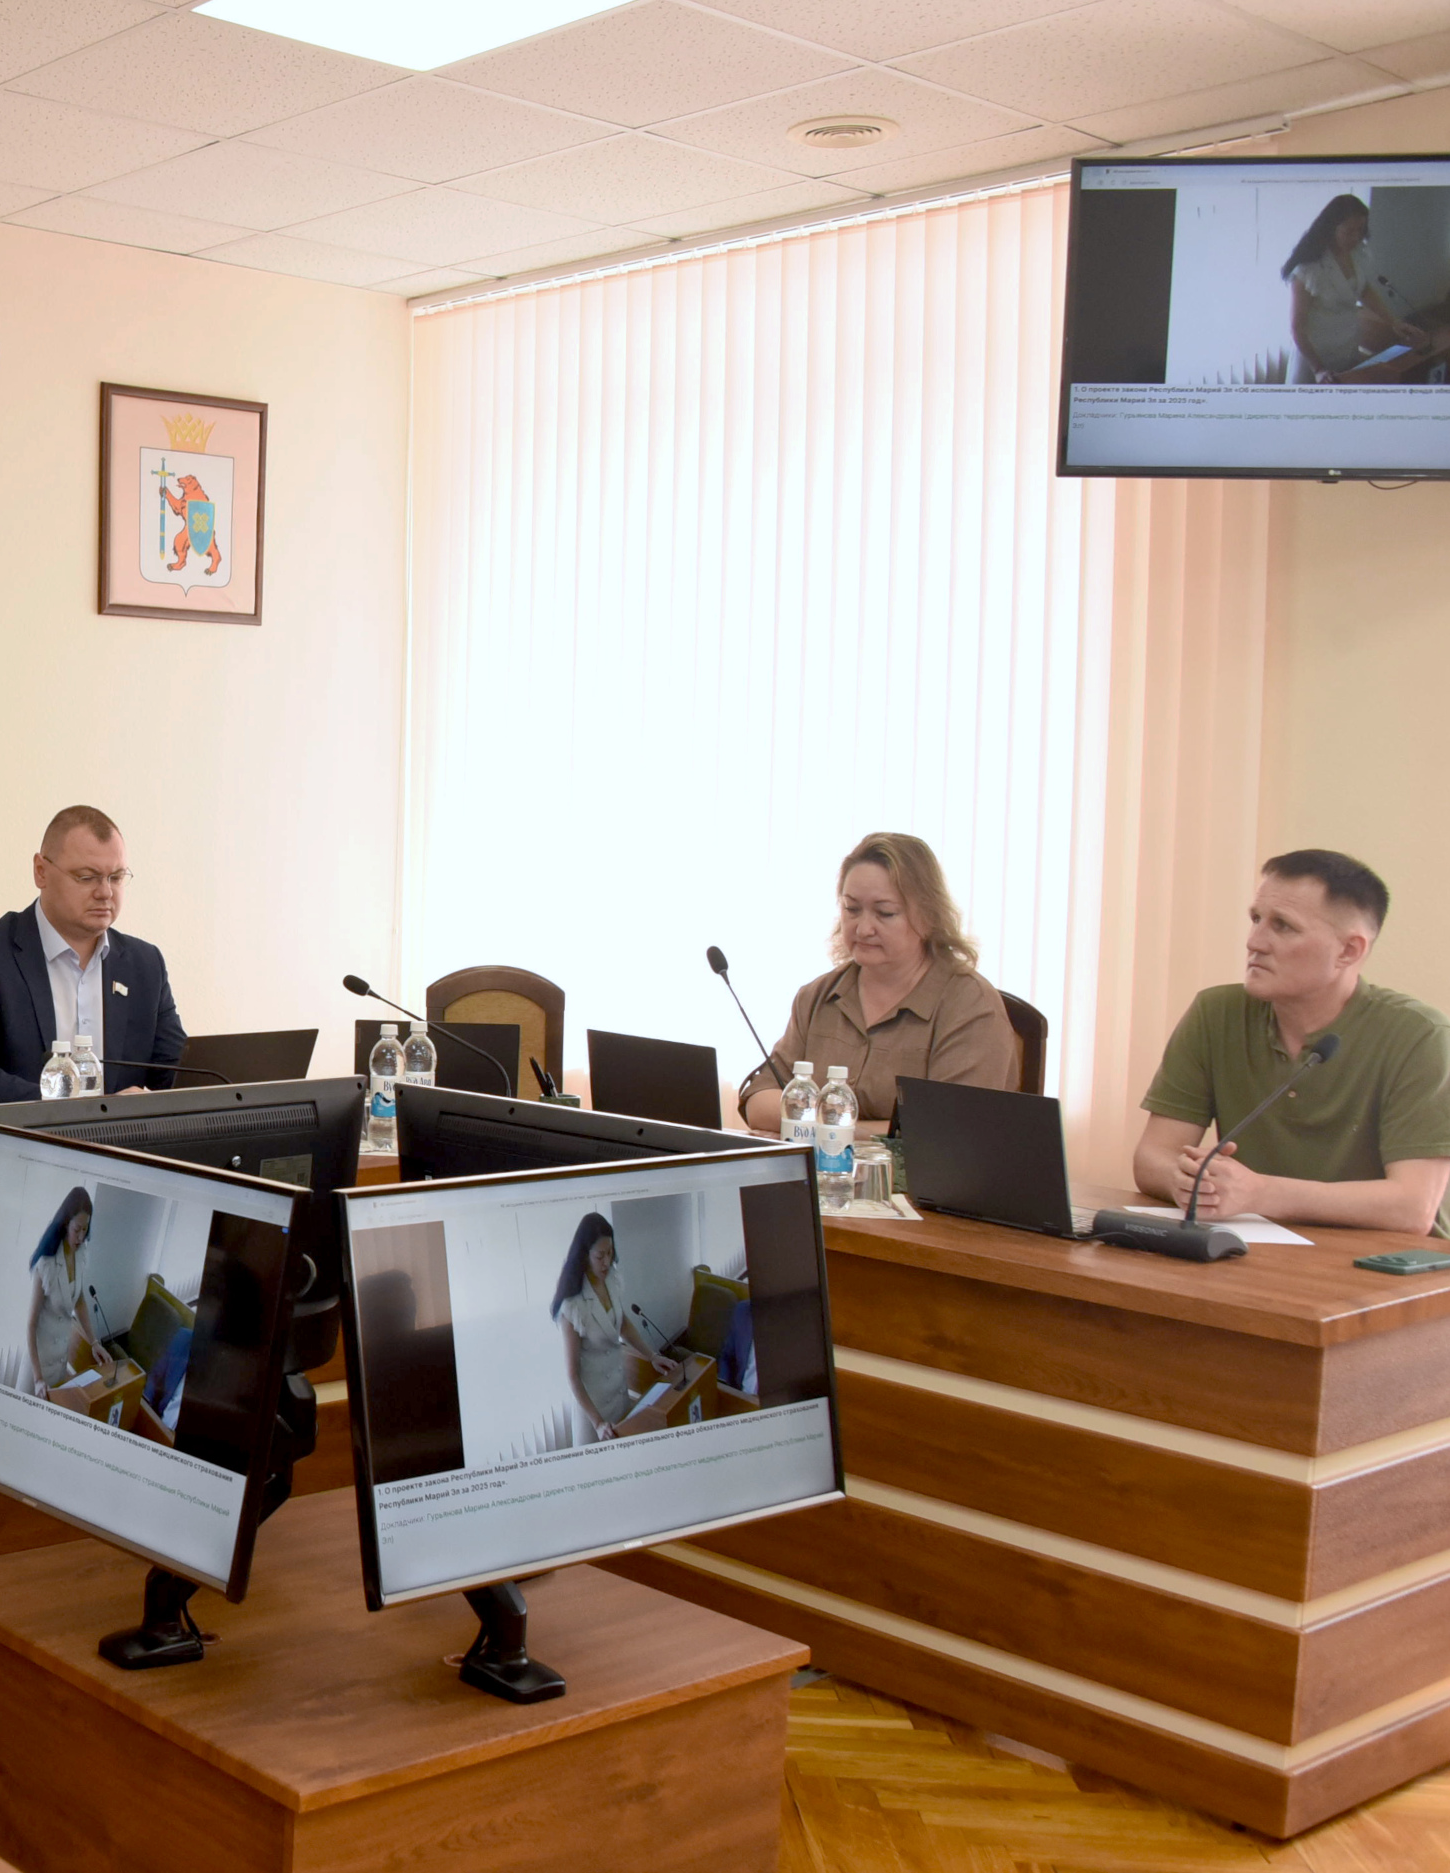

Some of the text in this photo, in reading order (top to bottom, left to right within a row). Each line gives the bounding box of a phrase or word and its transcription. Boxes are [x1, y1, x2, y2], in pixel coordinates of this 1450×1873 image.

[385, 1487, 390, 1495] О
[392, 1482, 422, 1494] проекте
[425, 1477, 449, 1487] закона
[451, 1469, 493, 1482] Республики
[495, 1463, 518, 1474] Марий
[520, 1461, 528, 1469] Эл
[544, 1451, 583, 1463] исполнении
[585, 1444, 615, 1456] бюджета
[616, 1433, 674, 1449] территориального
[675, 1428, 695, 1439] фонда
[696, 1419, 739, 1433] обязательного
[740, 1410, 782, 1424] медицинского
[379, 1496, 424, 1510] Республики
[425, 1490, 450, 1502] Марий
[451, 1488, 460, 1496] Эл
[471, 1482, 488, 1492] 2025
